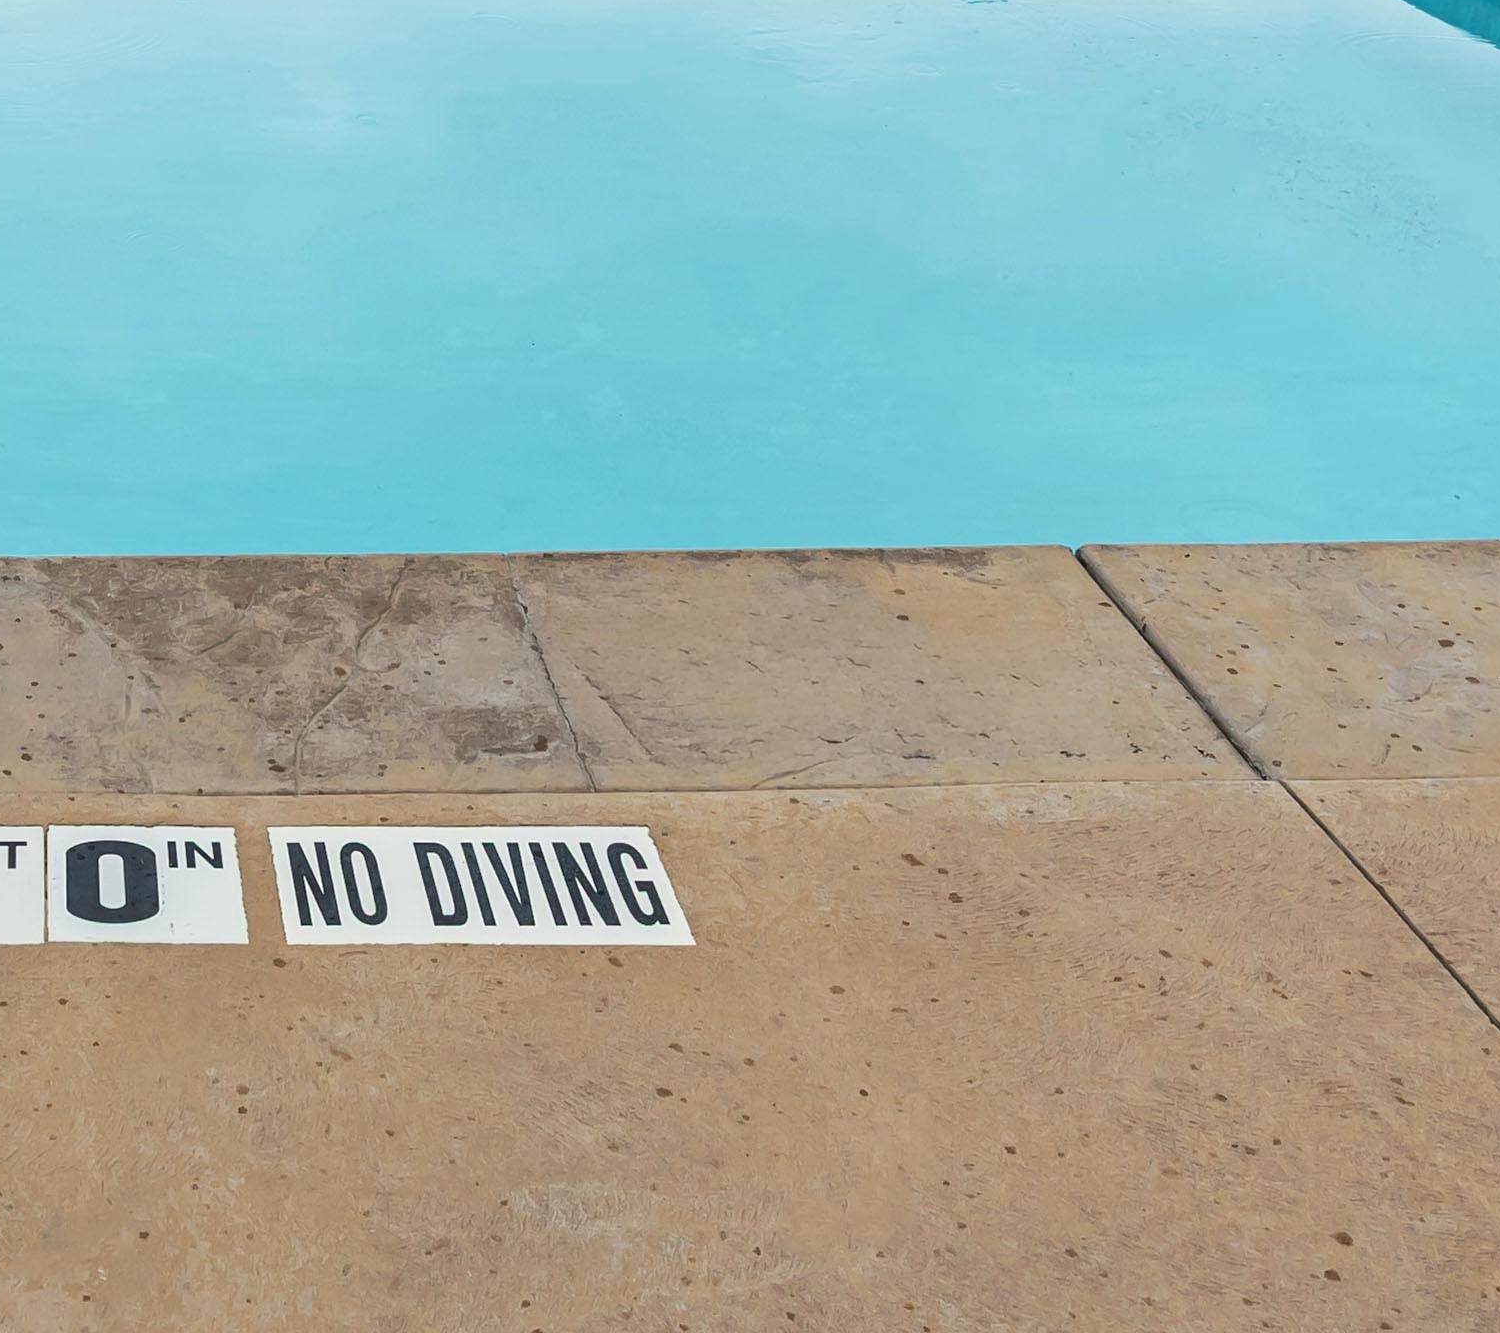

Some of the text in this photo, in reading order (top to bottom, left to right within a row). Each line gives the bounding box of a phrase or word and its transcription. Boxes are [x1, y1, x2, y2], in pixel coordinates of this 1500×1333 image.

[64, 839, 161, 926] 0
[168, 840, 225, 870] IN
[285, 840, 671, 928] NO DIVING
